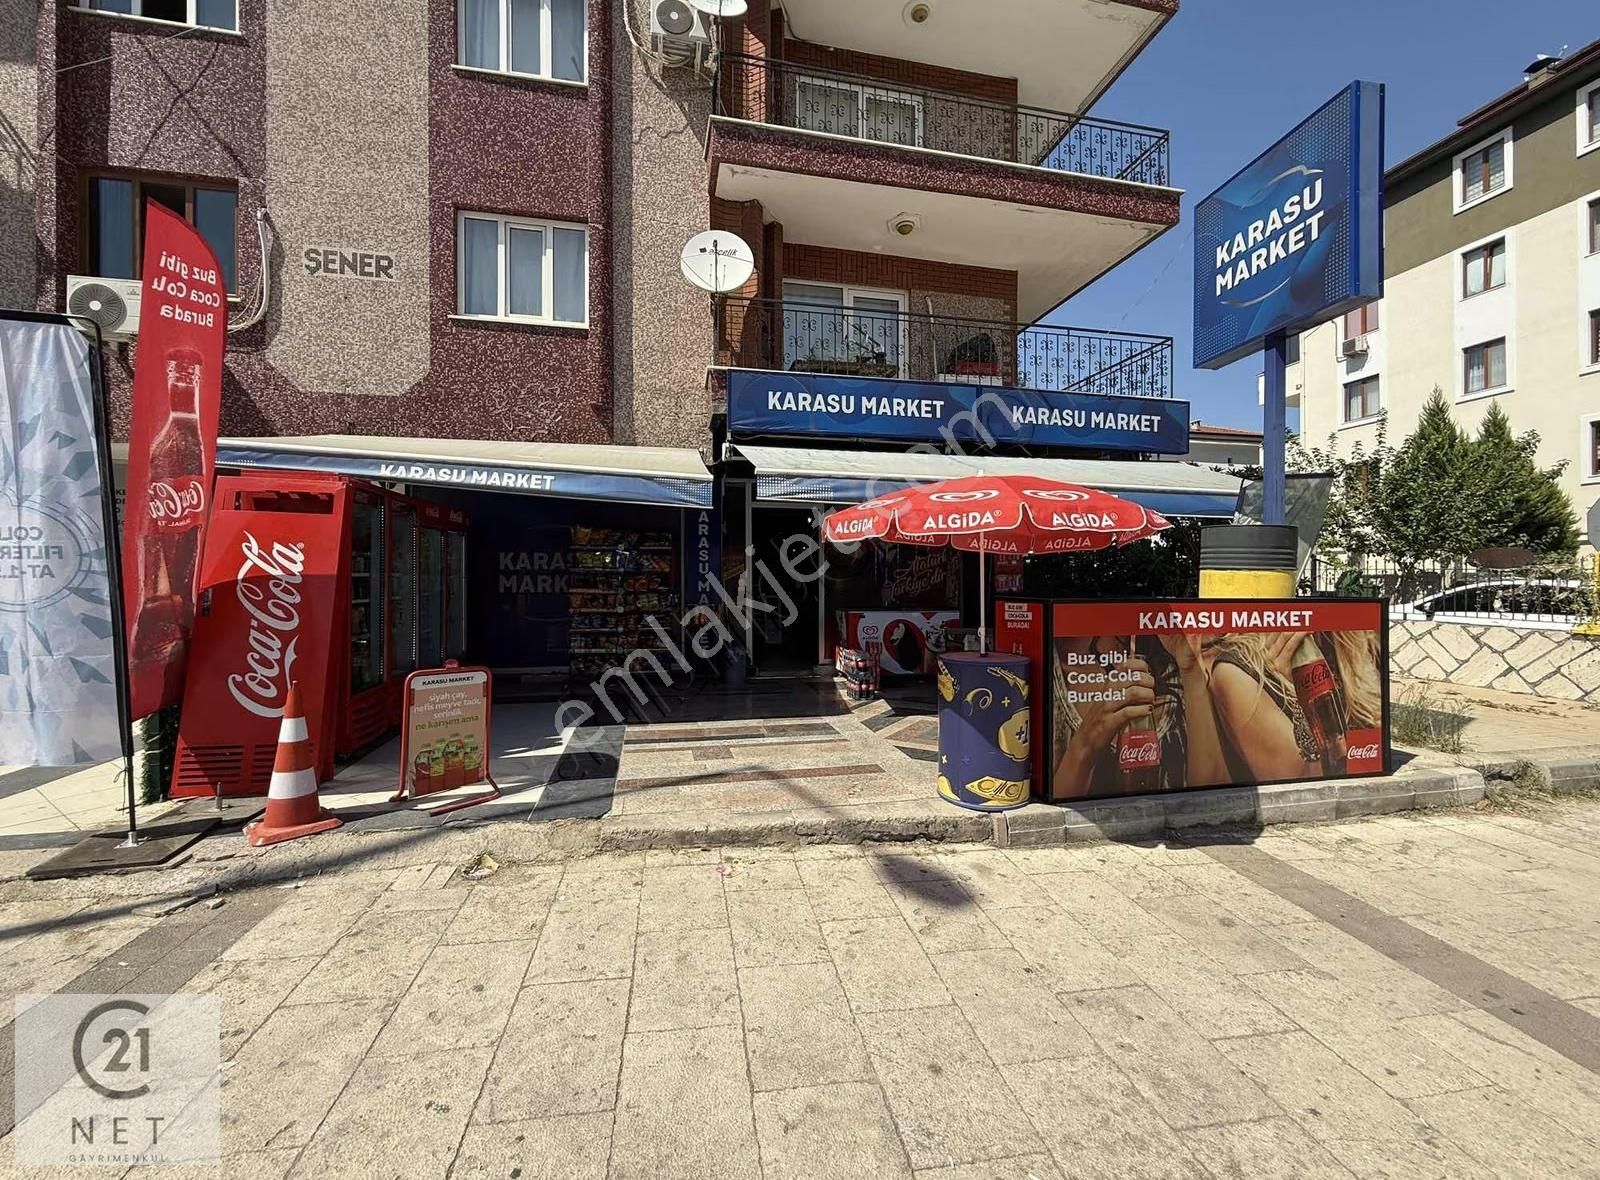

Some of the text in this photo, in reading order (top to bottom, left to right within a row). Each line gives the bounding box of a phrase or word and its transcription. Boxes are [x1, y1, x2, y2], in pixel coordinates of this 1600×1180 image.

[1215, 177, 1323, 269] KARASU
[1215, 210, 1325, 298] MARKET
[768, 390, 944, 418] KARASU MARKET
[1011, 405, 1161, 432] KARASU MARKET
[378, 464, 555, 490] KARASU MARKET
[499, 551, 572, 570] KARA
[499, 574, 568, 593] MARK
[1139, 610, 1313, 629] KARASU MARKET
[1067, 650, 1127, 667] Buz gibi
[422, 675, 474, 686] KARASU MARKET
[1067, 687, 1126, 703] Burada!
